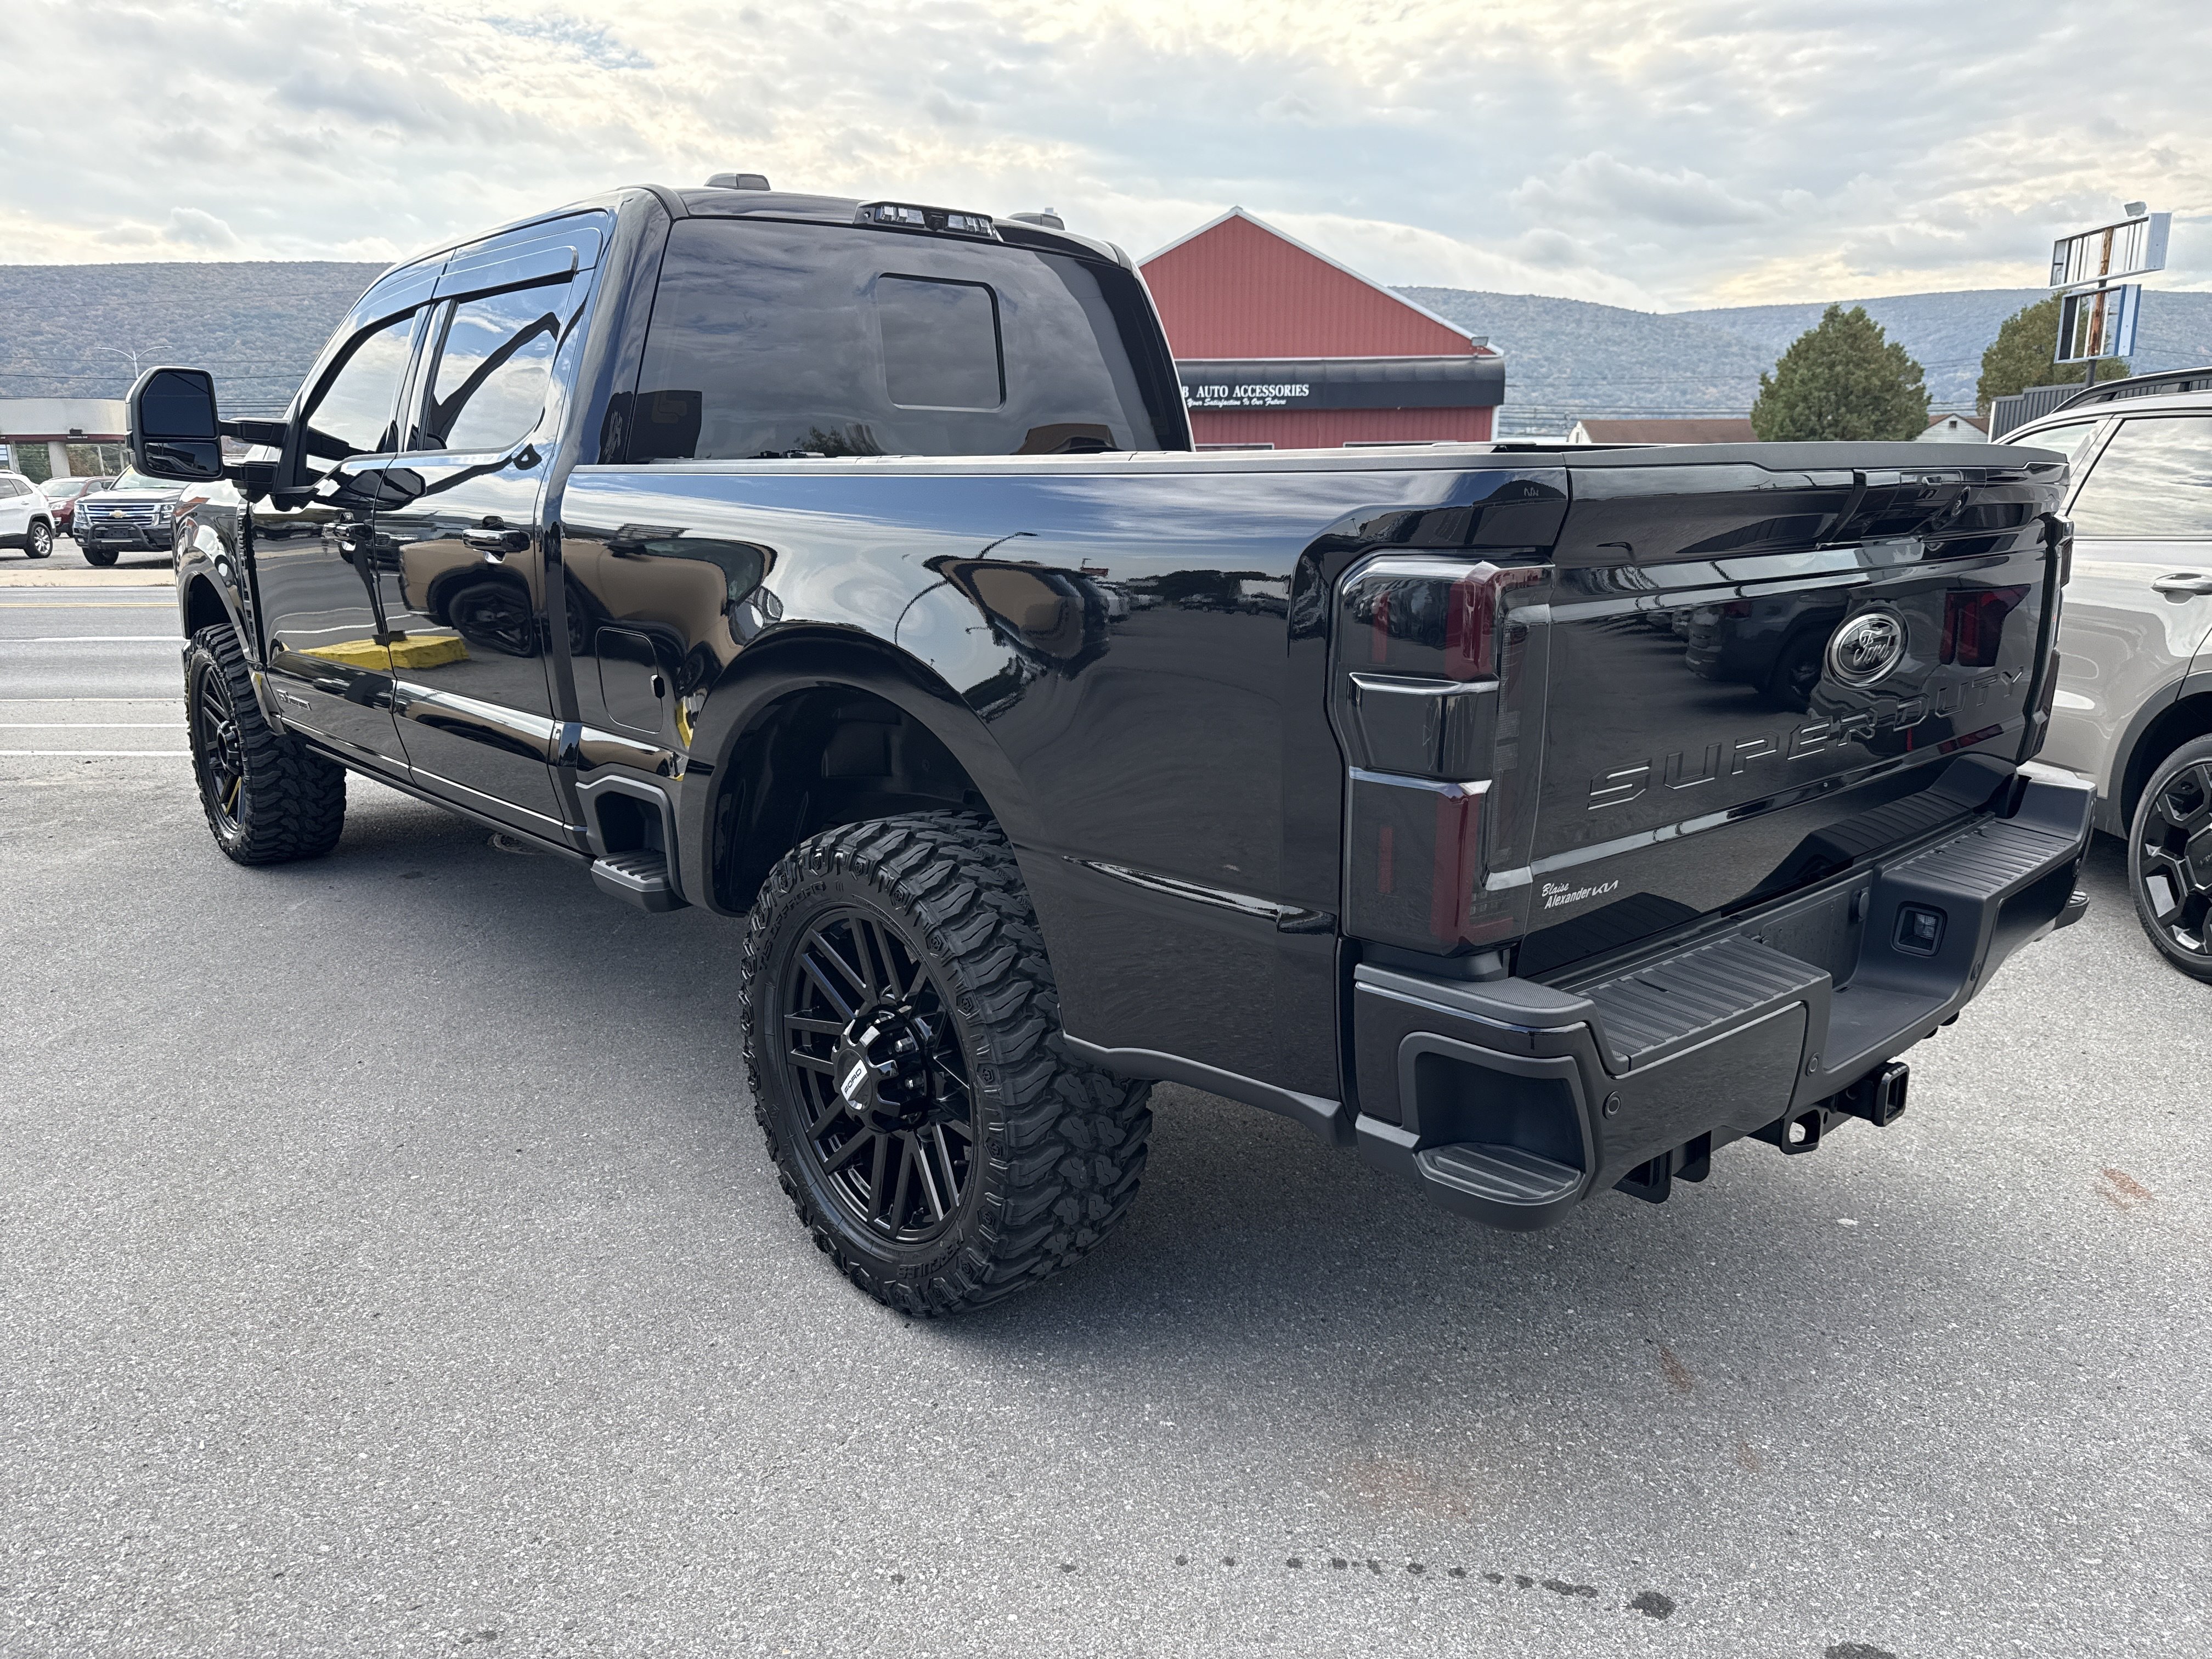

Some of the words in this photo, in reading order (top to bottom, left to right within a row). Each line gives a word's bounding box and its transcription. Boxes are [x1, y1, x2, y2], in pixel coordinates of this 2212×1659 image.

[1187, 398, 1203, 408] Your
[1204, 398, 1241, 408] Satisfaction
[1251, 397, 1263, 405] Our
[1265, 397, 1286, 406] Future
[1196, 385, 1228, 398] AUTO
[1232, 384, 1309, 397] ACCESSORIES
[1853, 629, 1892, 666] Ford
[1587, 707, 1877, 810] SUPER
[1893, 665, 2024, 732] DUTY
[1542, 882, 1570, 897] Blaise
[1544, 887, 1592, 910] Alexander
[844, 1068, 862, 1094] FORD
